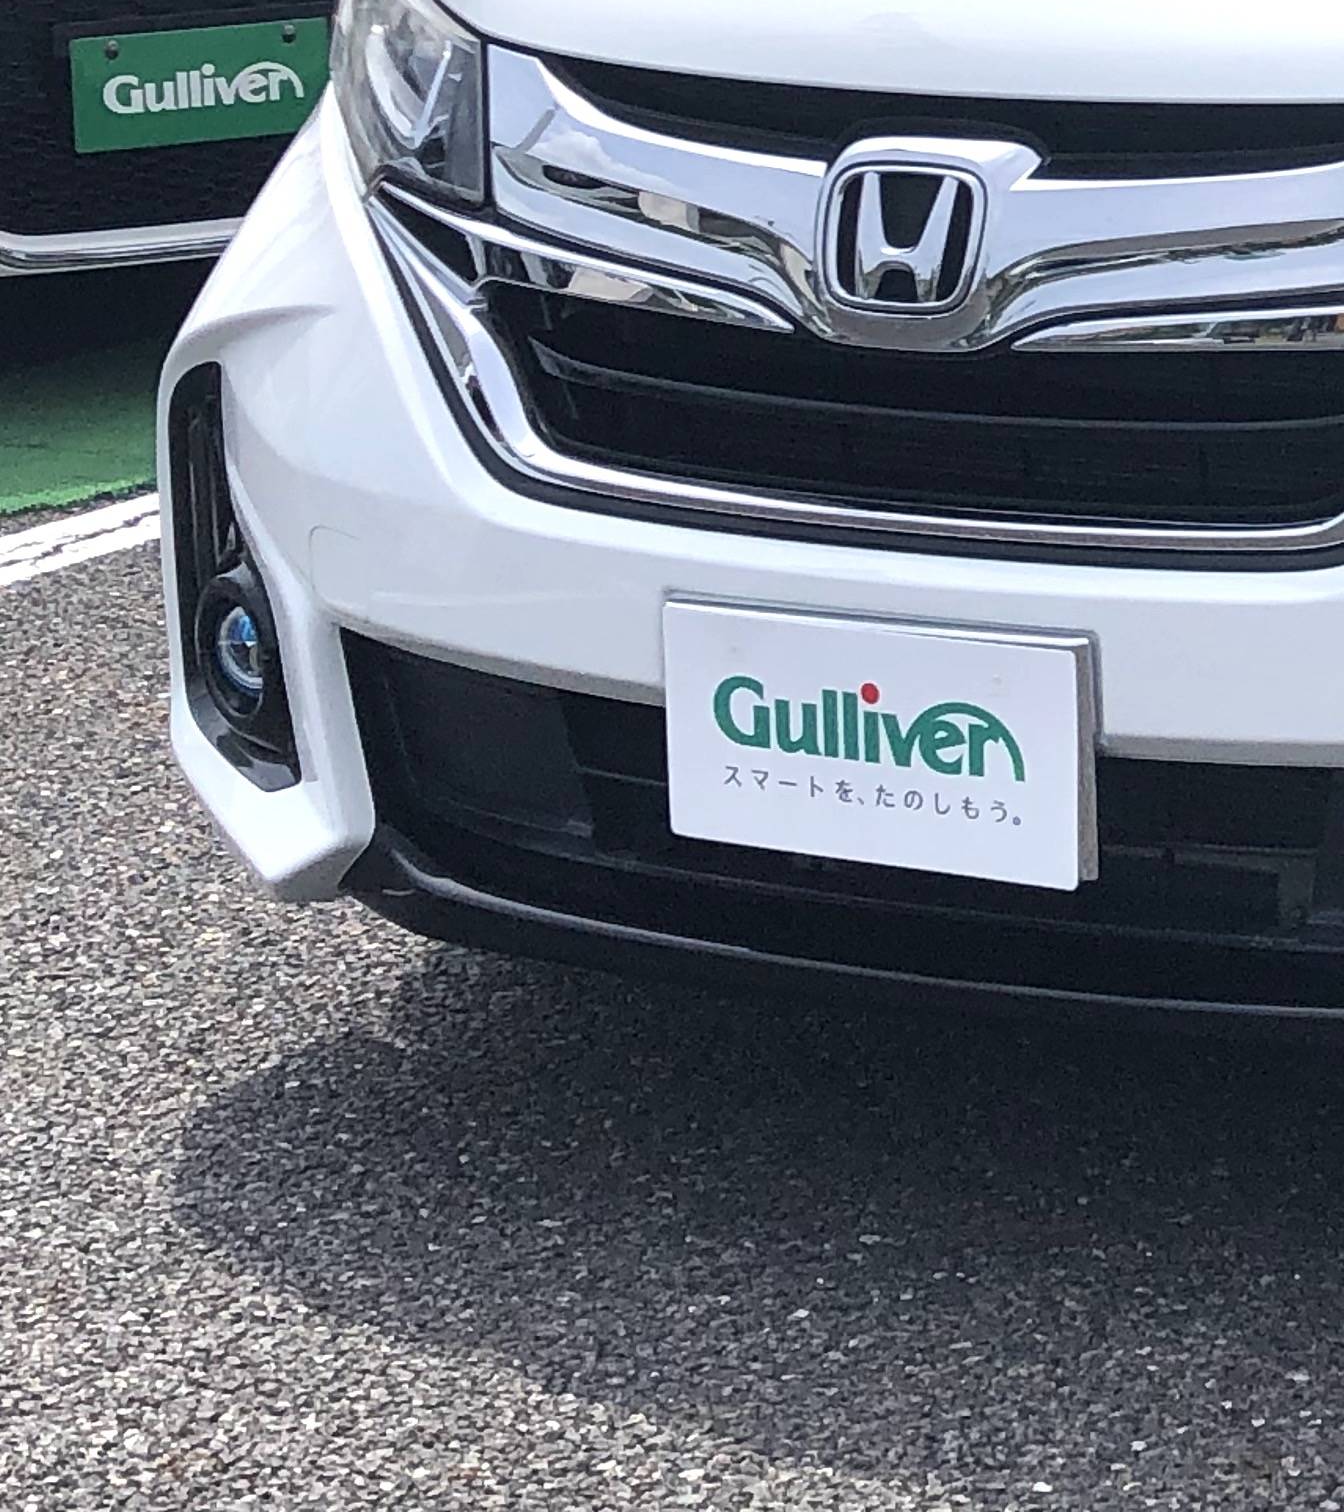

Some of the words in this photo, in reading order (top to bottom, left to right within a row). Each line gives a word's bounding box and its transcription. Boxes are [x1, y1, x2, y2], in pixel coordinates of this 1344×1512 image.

[103, 61, 304, 114] Gulliver
[713, 675, 1026, 783] Gulliver
[723, 765, 1023, 827] スマートを、たのしもう。
